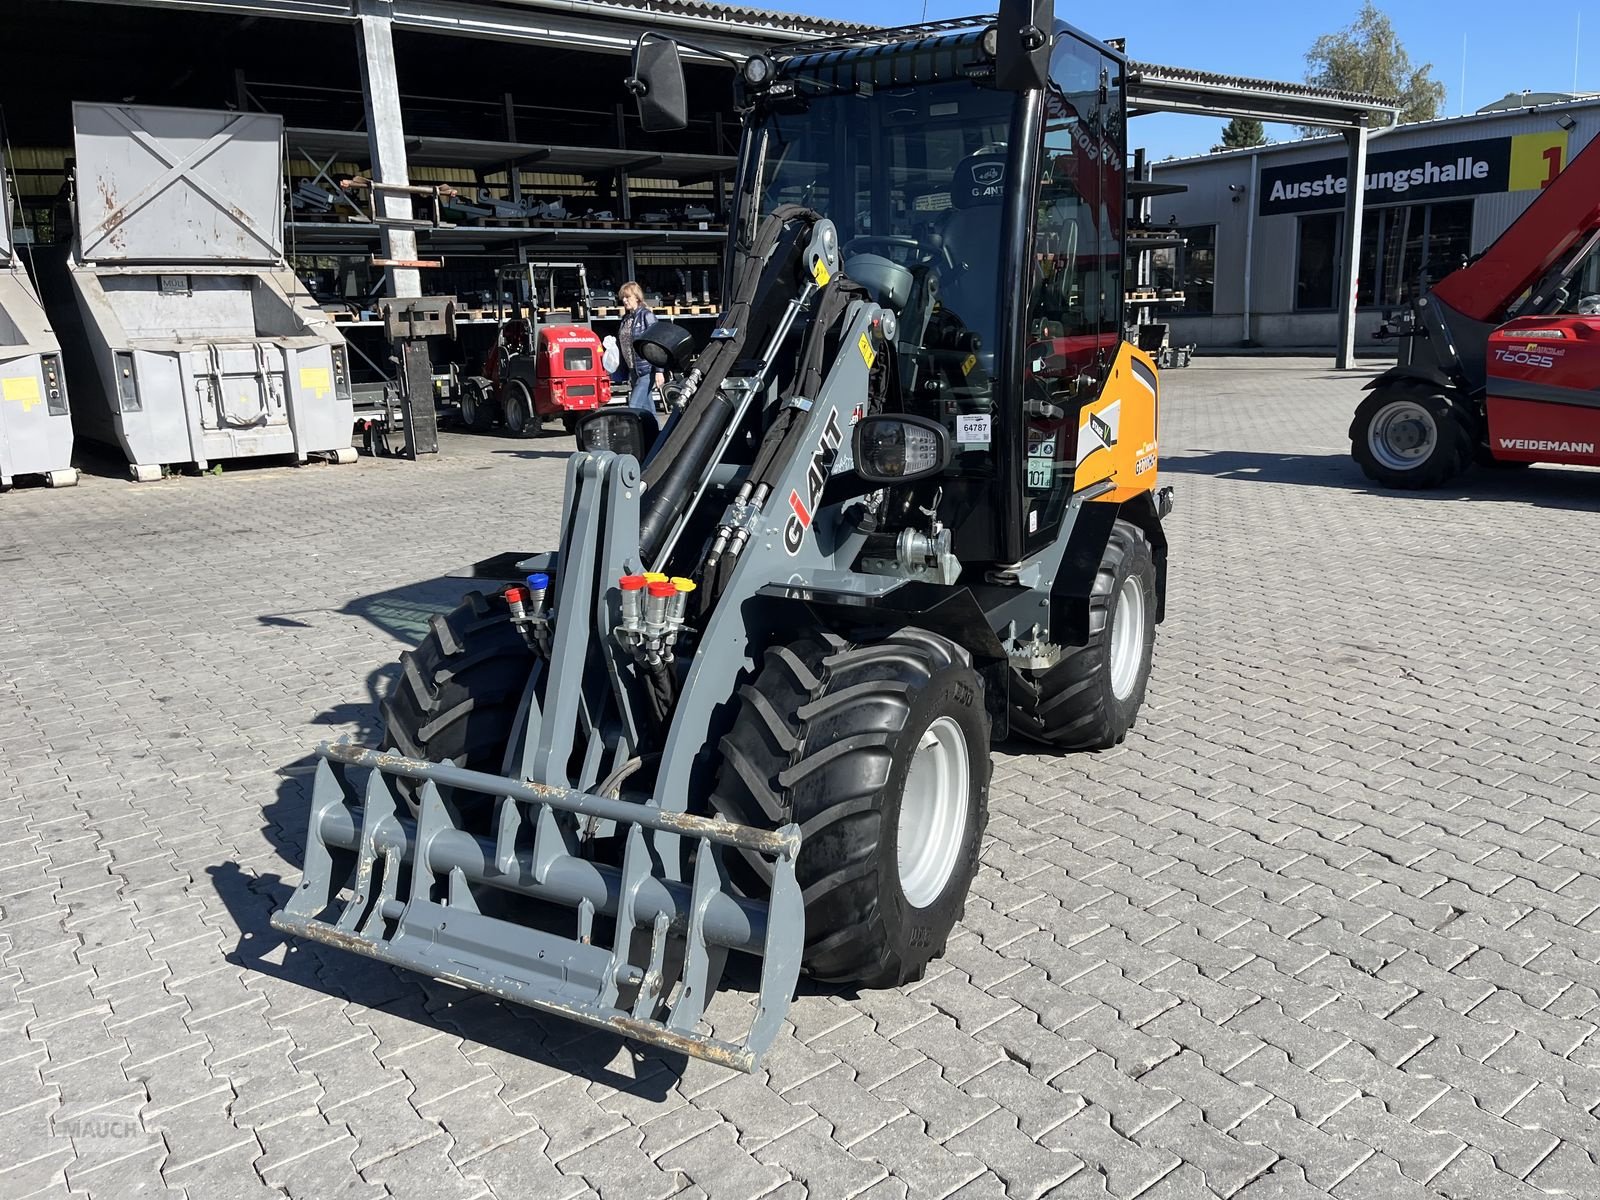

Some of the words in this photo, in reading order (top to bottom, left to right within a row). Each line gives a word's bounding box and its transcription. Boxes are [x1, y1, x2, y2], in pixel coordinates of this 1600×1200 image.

[1269, 157, 1489, 201] Aussteungshalle
[1541, 146, 1561, 190] 1
[1495, 349, 1553, 368] T6025
[964, 424, 987, 432] 64787
[1499, 438, 1594, 453] WEIDEMANN
[783, 404, 844, 557] GIANT
[1029, 471, 1045, 486] 101
